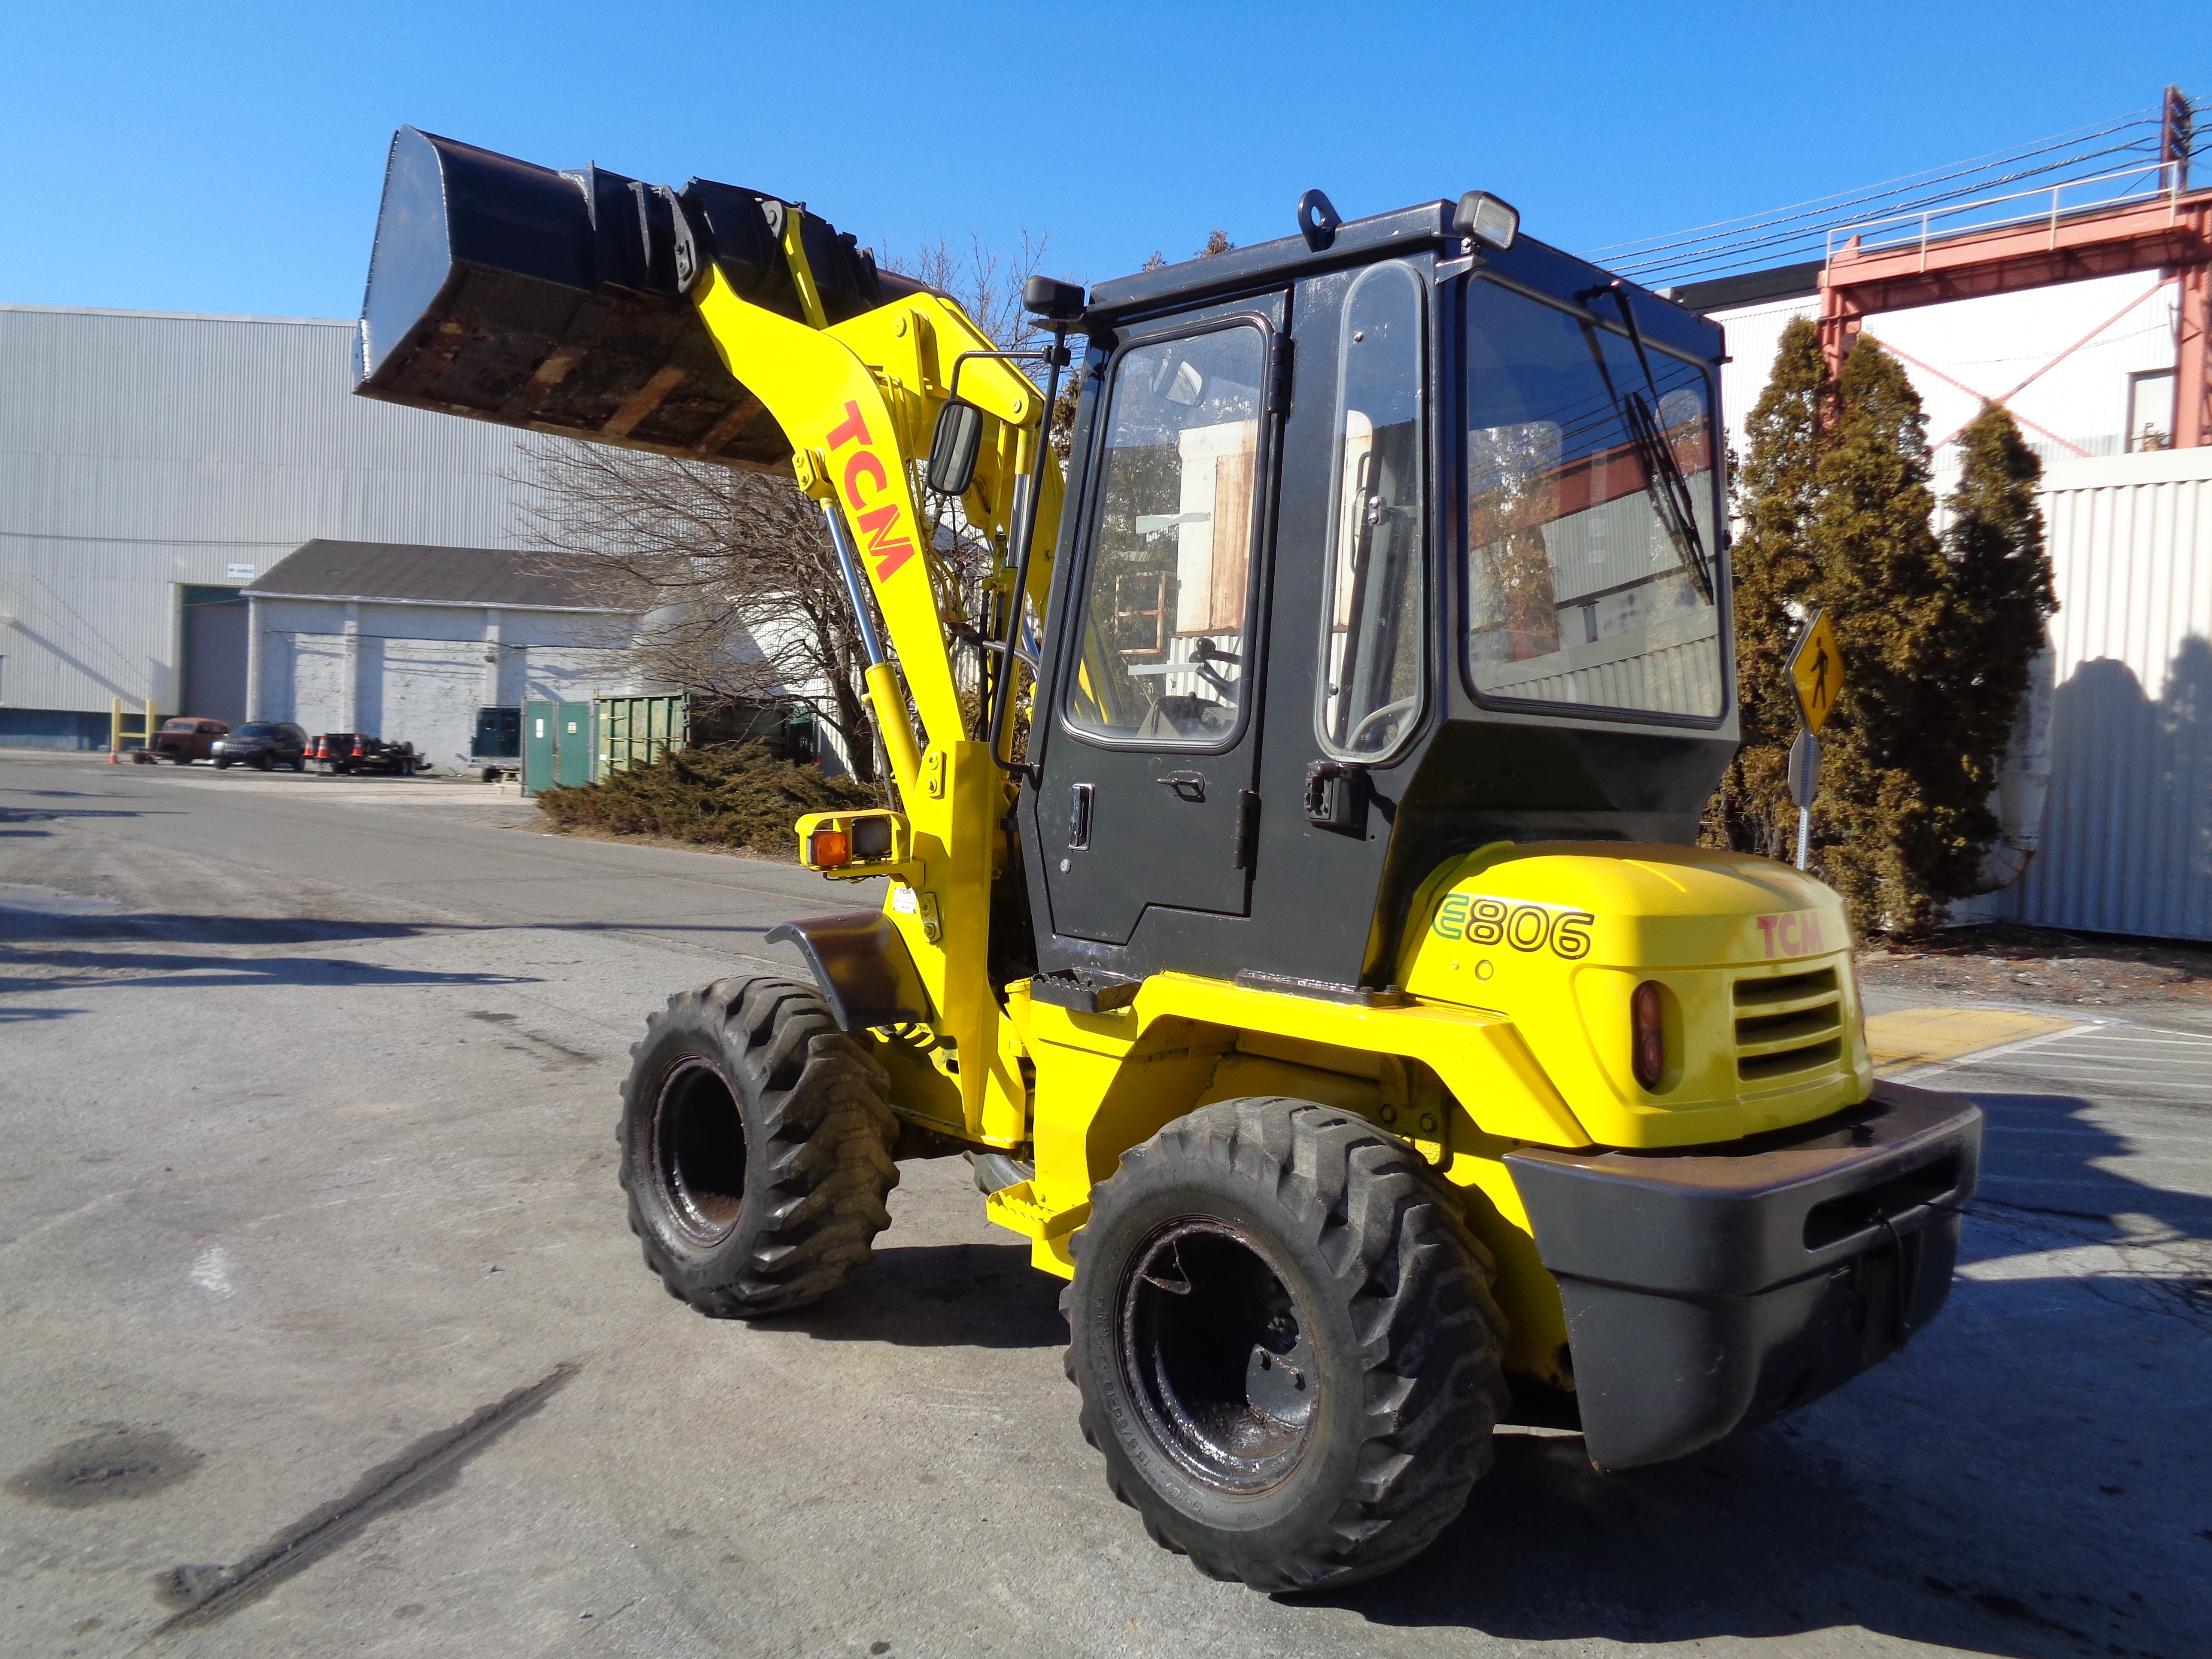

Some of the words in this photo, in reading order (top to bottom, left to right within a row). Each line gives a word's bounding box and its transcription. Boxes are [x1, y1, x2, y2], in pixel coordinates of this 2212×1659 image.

[826, 400, 915, 583] TCM
[1432, 893, 1595, 960] E806
[1756, 912, 1824, 958] TCM
